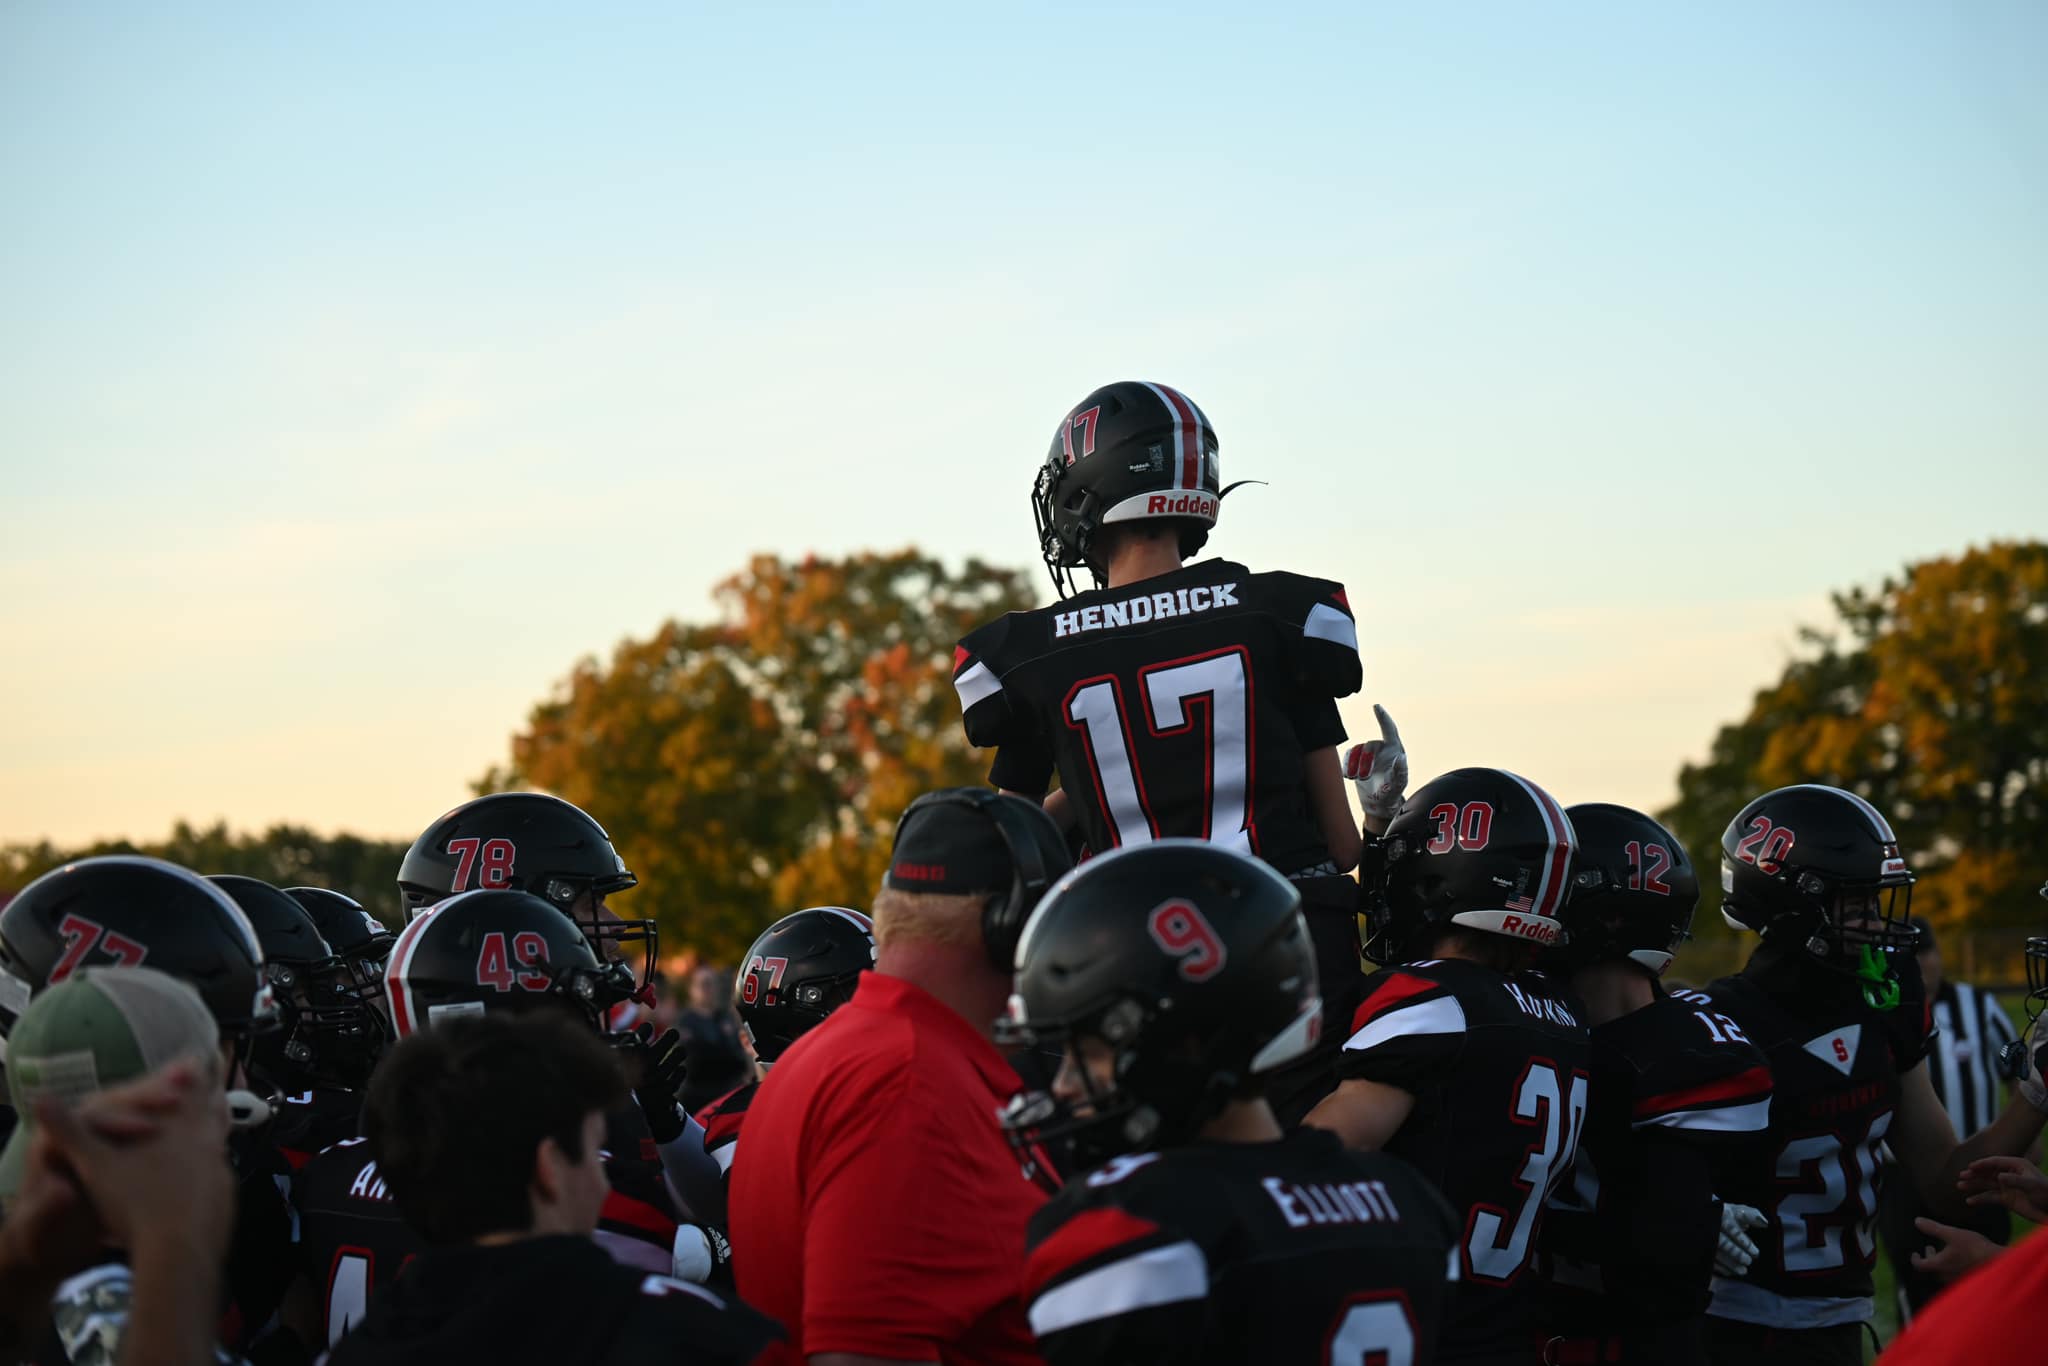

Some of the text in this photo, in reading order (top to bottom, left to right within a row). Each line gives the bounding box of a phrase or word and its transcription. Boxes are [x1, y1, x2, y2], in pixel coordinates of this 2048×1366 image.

[1061, 405, 1100, 468] 17
[1148, 495, 1218, 517] Riddell
[1054, 582, 1240, 638] HENDRICK
[1061, 644, 1258, 851] 17
[1426, 801, 1494, 856] 30
[1734, 815, 1796, 876] 20
[447, 837, 516, 894] 78
[1624, 840, 1672, 896] 12
[476, 931, 552, 992] 49
[1147, 898, 1228, 983] 9
[743, 955, 789, 1007] 67
[1693, 1010, 1754, 1046] 12
[1831, 1037, 1849, 1063] S
